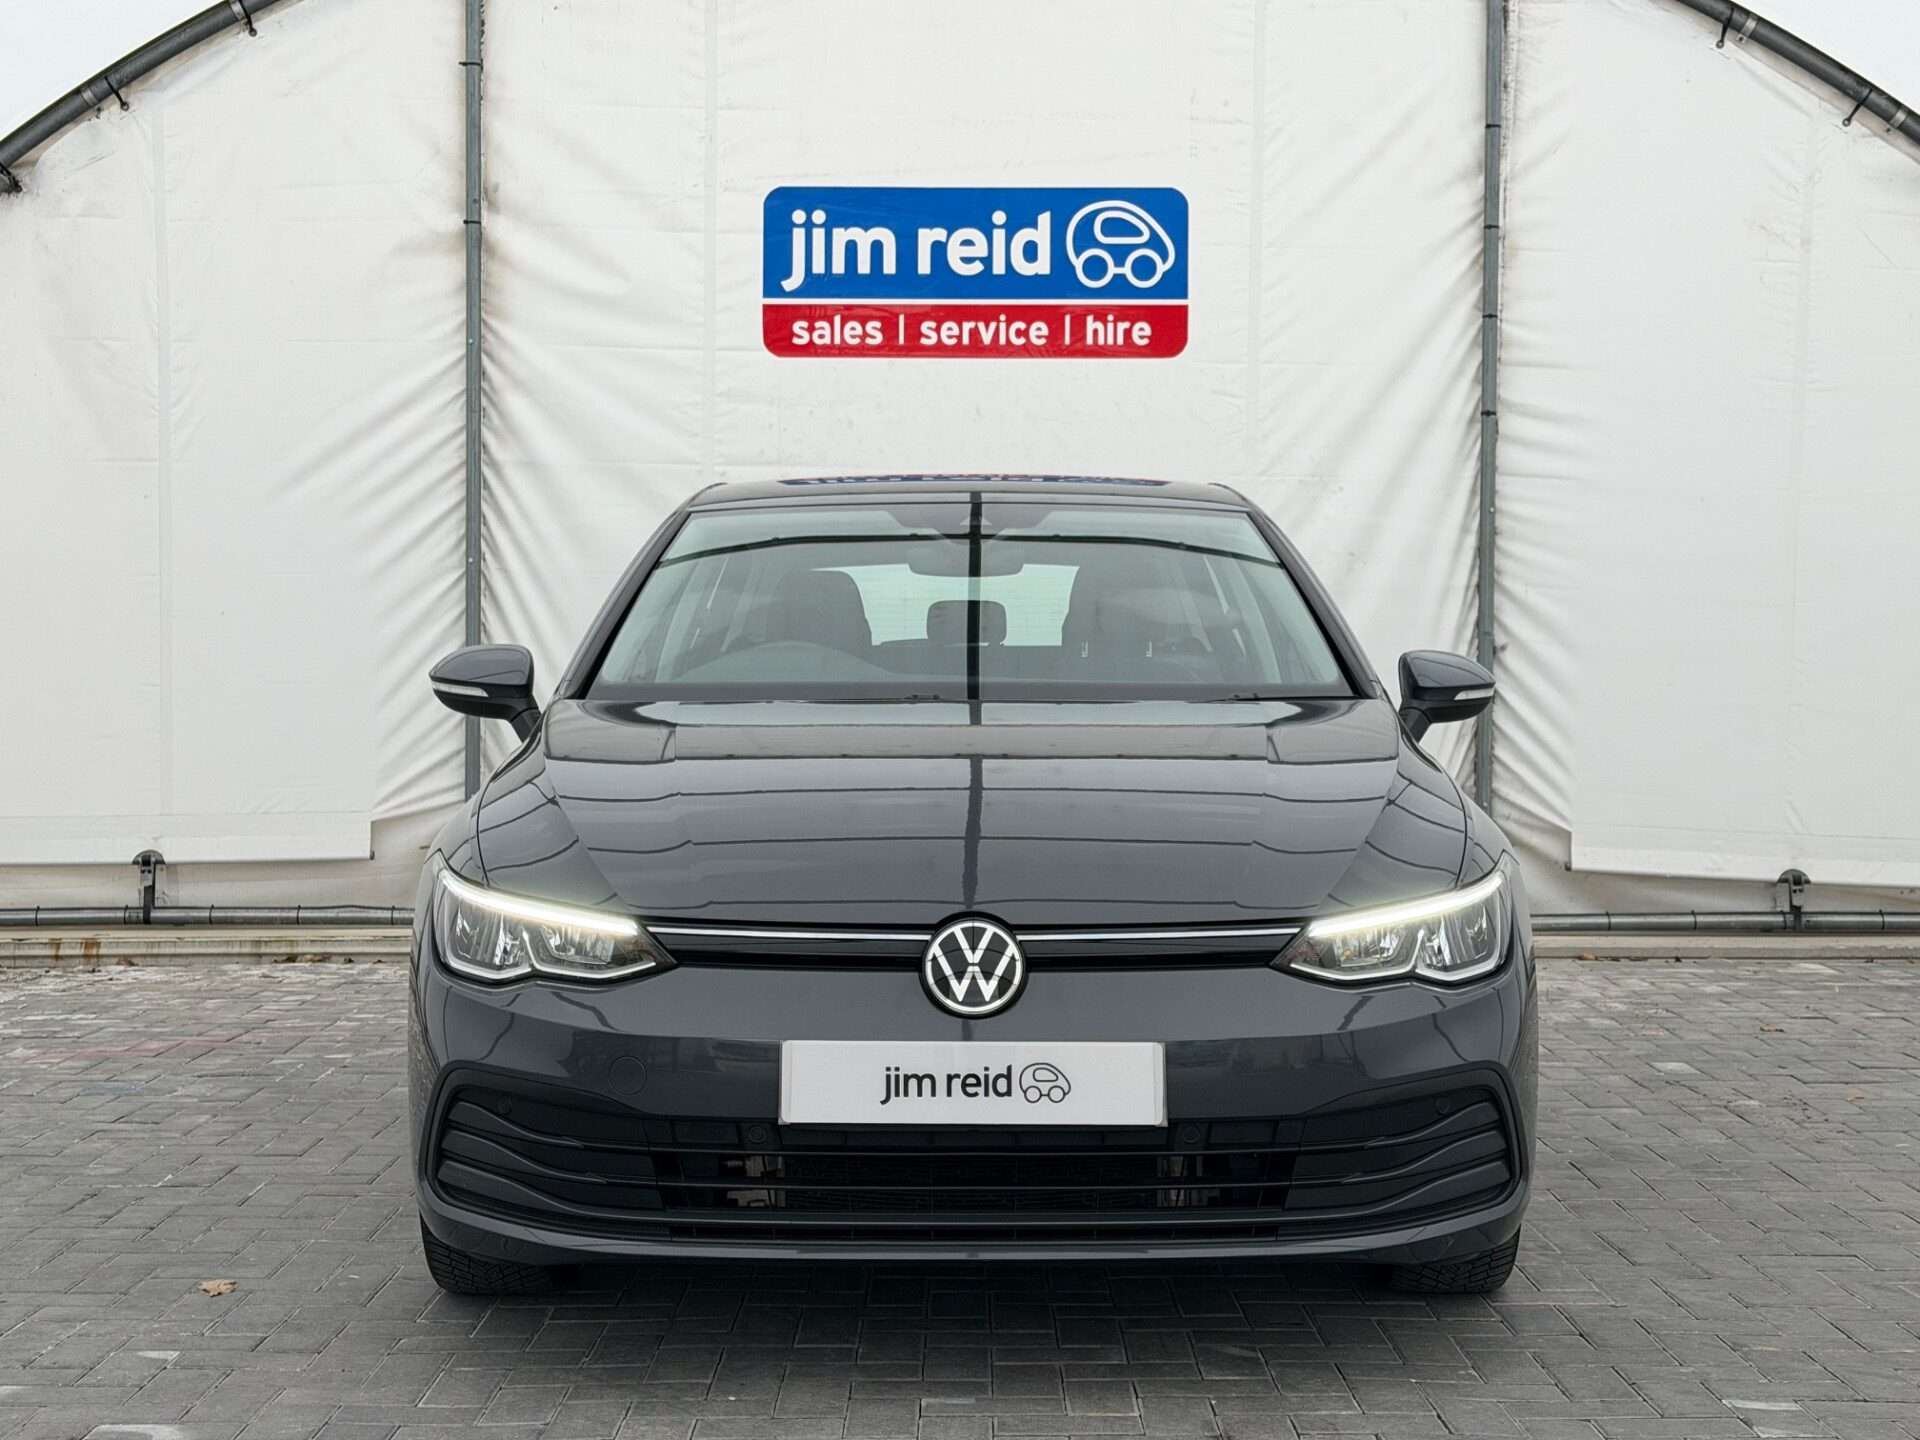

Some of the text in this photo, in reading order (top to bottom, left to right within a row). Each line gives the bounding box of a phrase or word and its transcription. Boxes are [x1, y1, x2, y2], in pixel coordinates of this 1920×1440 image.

[780, 209, 1051, 292] jim reid
[792, 313, 1152, 346] sales service hire
[880, 1064, 1013, 1105] jim reid
